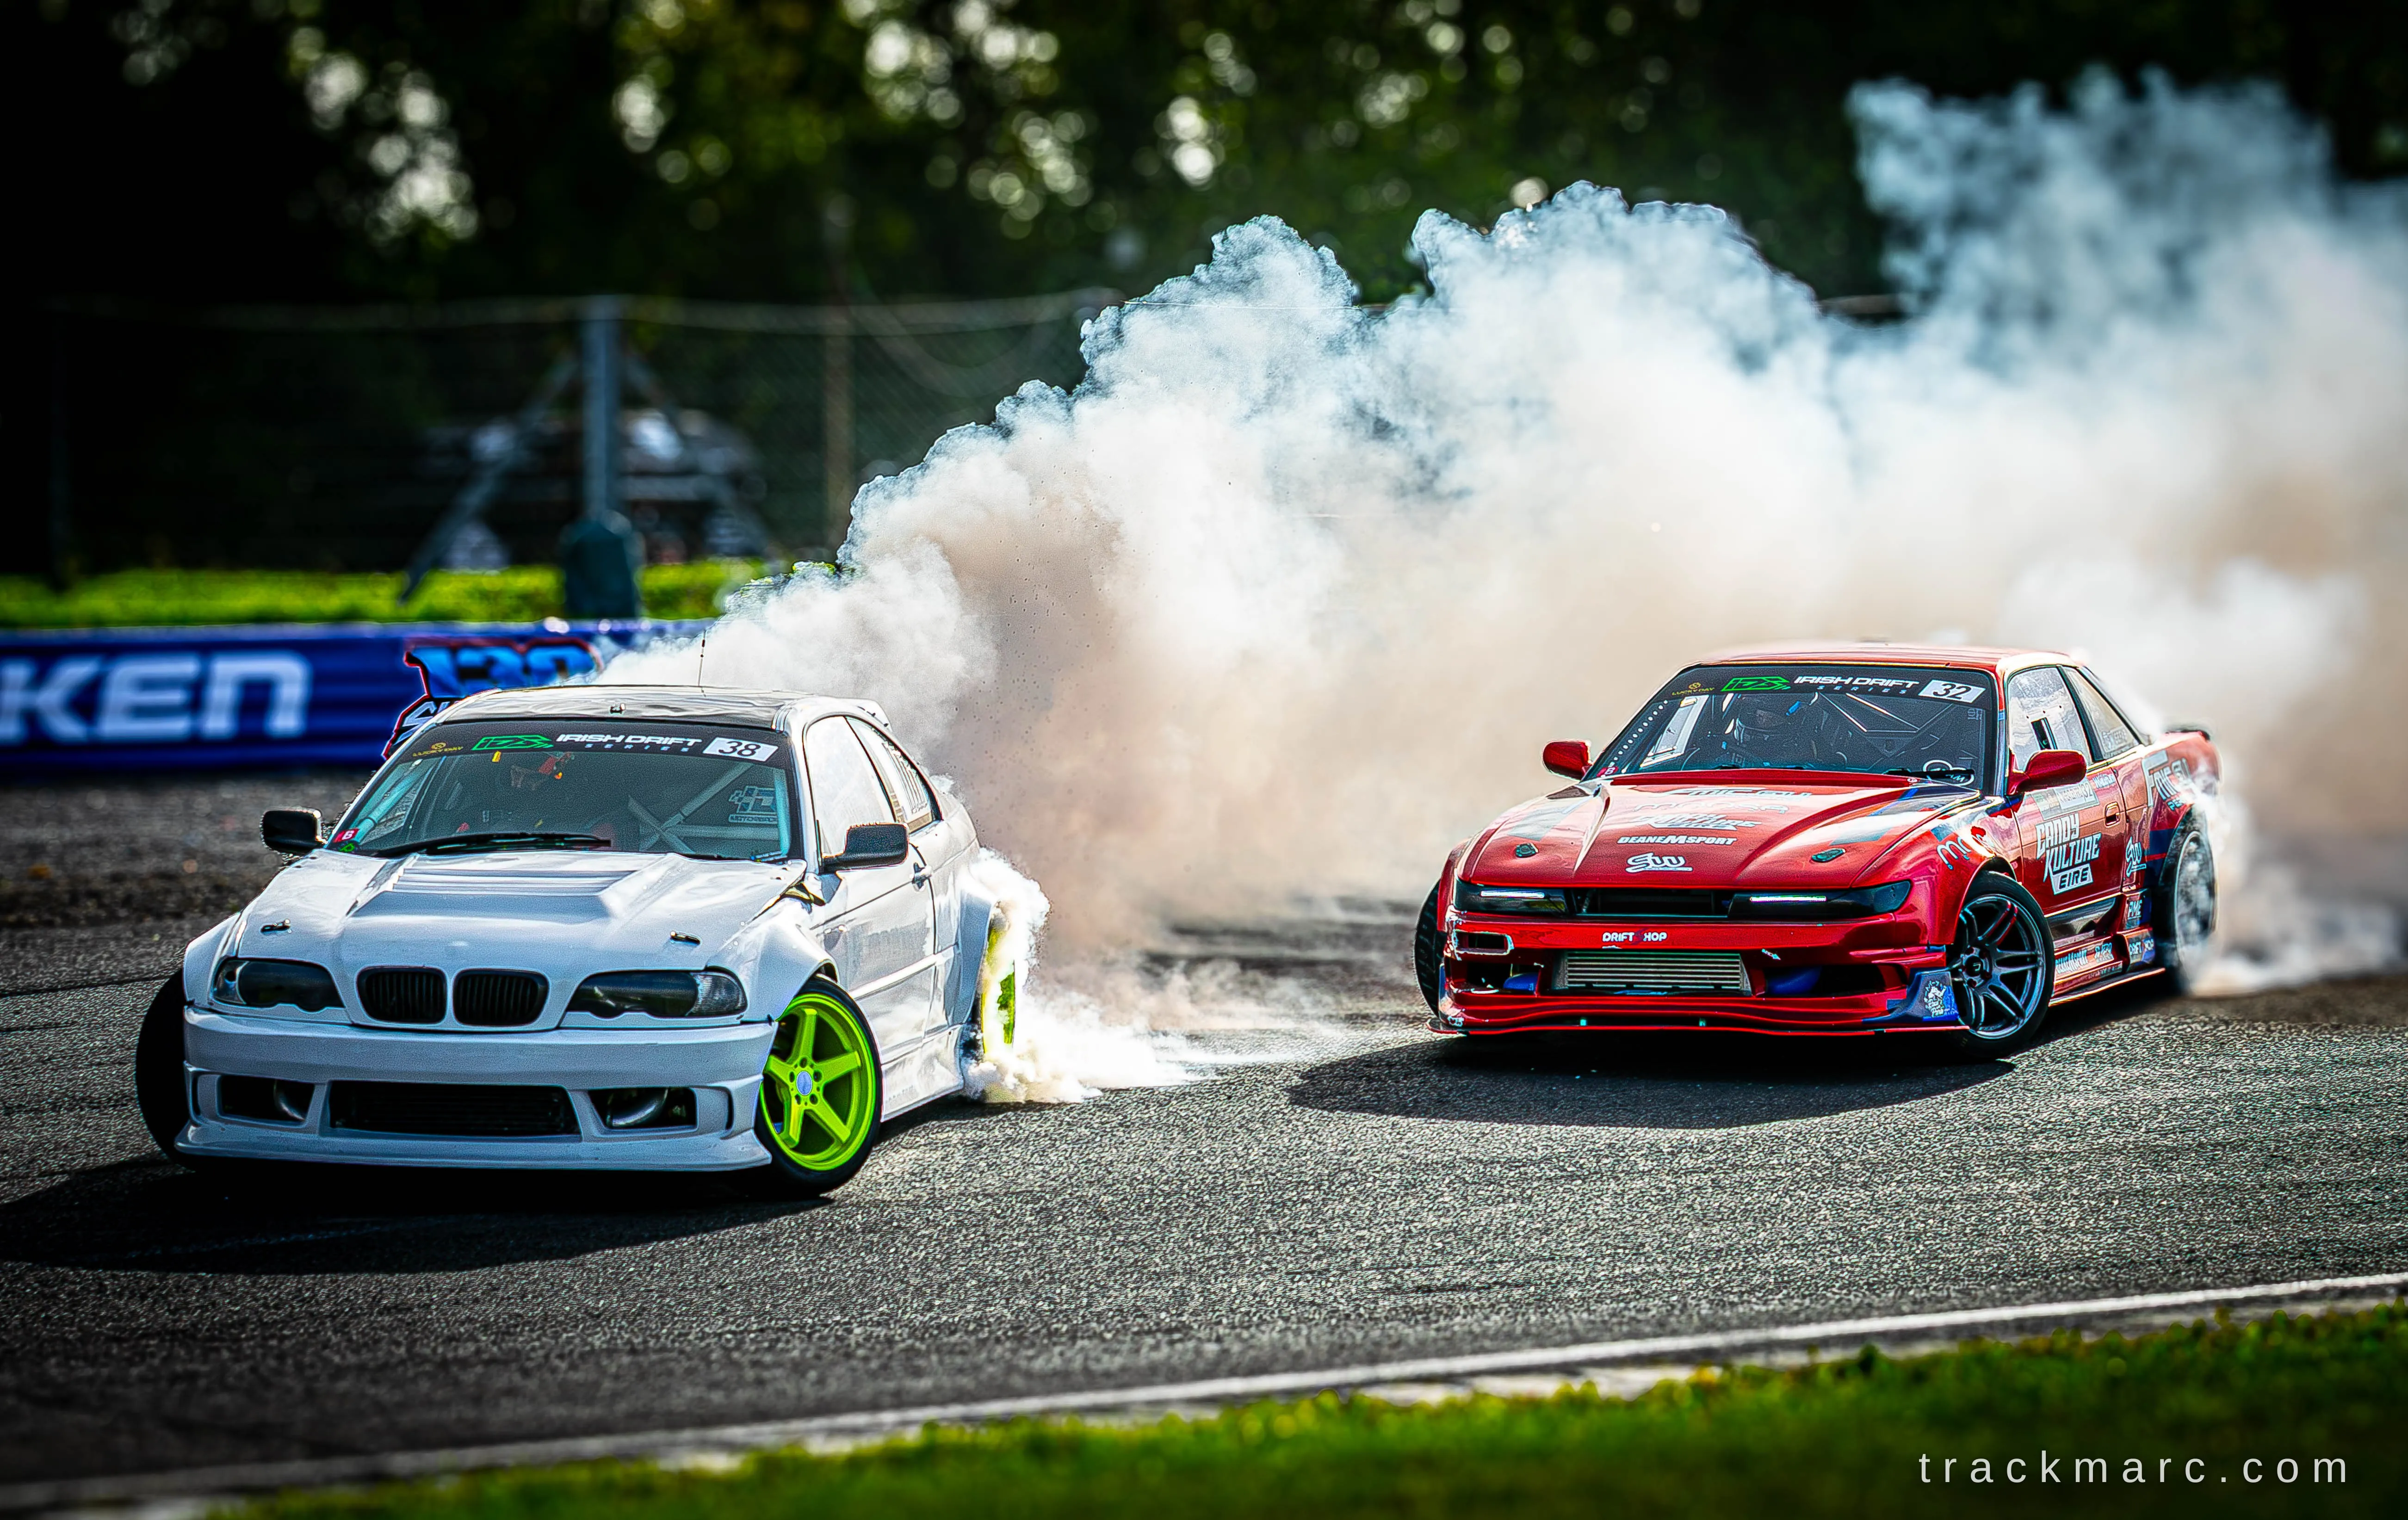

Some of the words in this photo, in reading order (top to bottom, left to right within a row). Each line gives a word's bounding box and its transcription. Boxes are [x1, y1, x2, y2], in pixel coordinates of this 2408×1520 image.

[1794, 676, 1851, 685] IRISH
[1852, 677, 1919, 688] DRIFT
[1817, 685, 1907, 694] SERIES
[1933, 683, 1972, 700] 32
[556, 734, 625, 743] IRISH
[625, 735, 702, 746] DRIFT
[584, 743, 689, 752] SERIES
[718, 741, 761, 757] 38
[2058, 866, 2089, 890] EIRE
[1602, 932, 1635, 942] DRIFT
